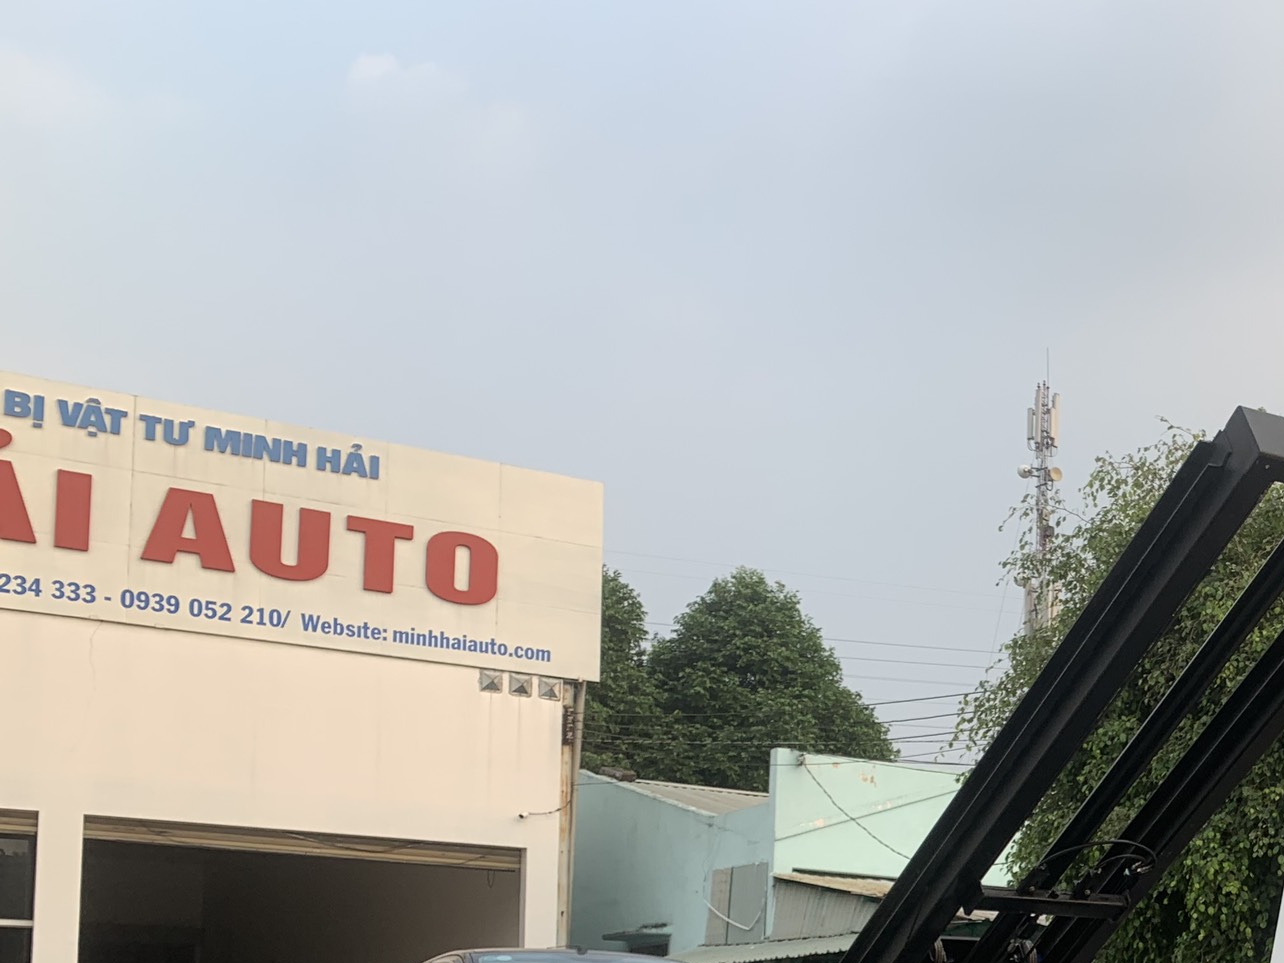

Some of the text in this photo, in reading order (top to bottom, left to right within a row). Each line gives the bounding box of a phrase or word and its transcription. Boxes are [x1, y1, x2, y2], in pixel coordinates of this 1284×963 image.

[4, 389, 380, 480] BỊ VẬT TƯ MINH HẢI
[140, 487, 499, 605] AUTO
[0, 573, 42, 597] 234
[51, 580, 97, 603] 333
[120, 589, 180, 614] 0939
[189, 598, 232, 622] 052
[240, 605, 291, 628] 210/
[300, 613, 388, 641] Website:
[393, 629, 551, 662] minhhaiauto.com
